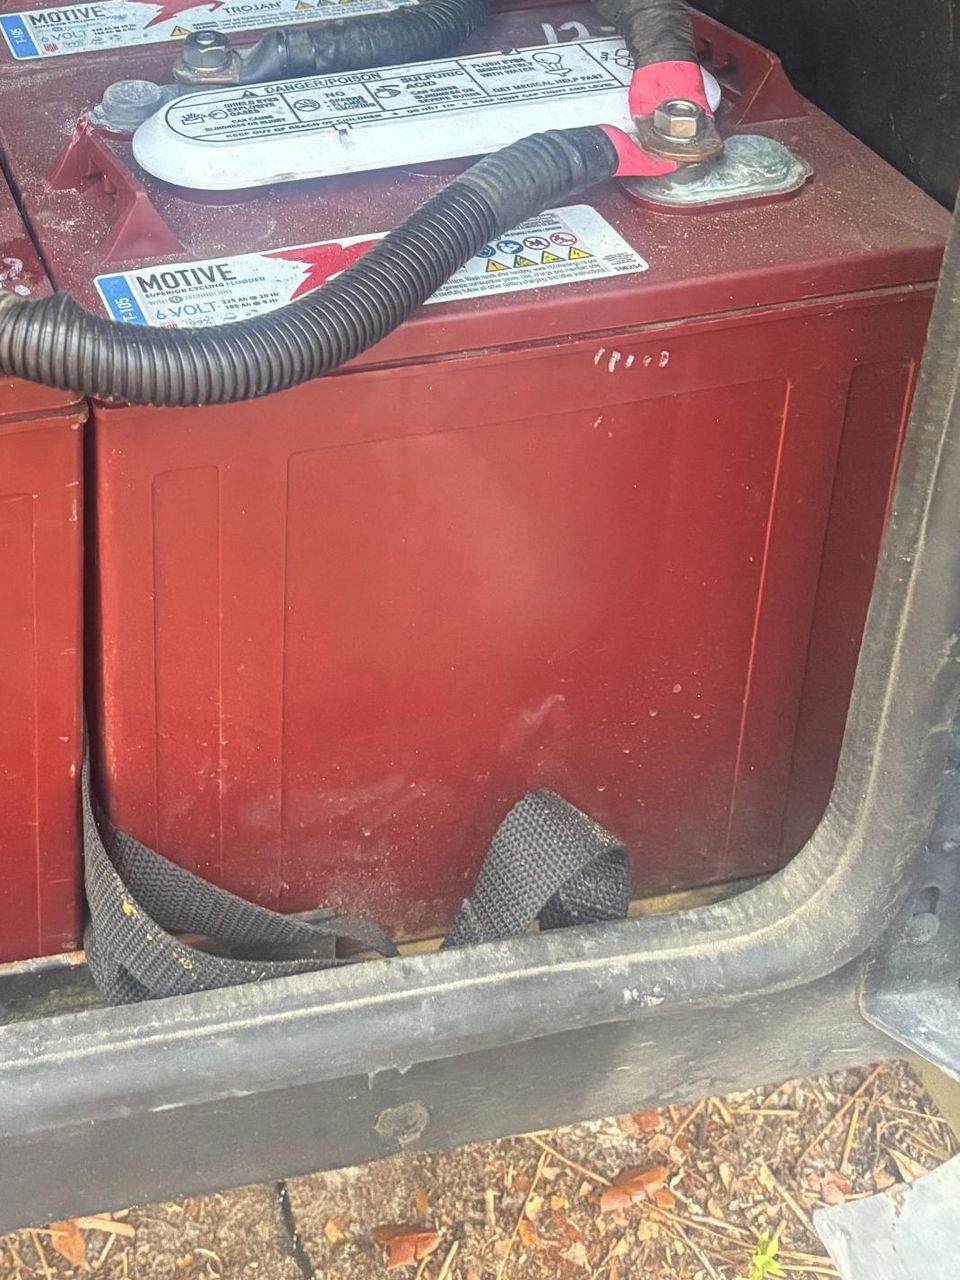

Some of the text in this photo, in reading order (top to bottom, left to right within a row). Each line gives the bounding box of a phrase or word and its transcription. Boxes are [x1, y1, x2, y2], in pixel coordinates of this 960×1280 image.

[27, 6, 106, 26] MOTIVE
[222, 1, 280, 15] TROJAN
[52, 29, 88, 42] VOLT
[263, 71, 384, 94] DANGER/POISON
[400, 69, 465, 84] SULFURIC
[479, 70, 501, 78] WITH
[492, 73, 605, 93] GET MEDICAL HELP FAST
[324, 90, 346, 98] NO
[405, 80, 437, 90] ACID
[136, 263, 237, 294] MOTIVE
[145, 276, 267, 299] SUPERIOR CYCLING FLOODED
[113, 297, 138, 322] T-105
[156, 300, 218, 321] 6 VOLT
